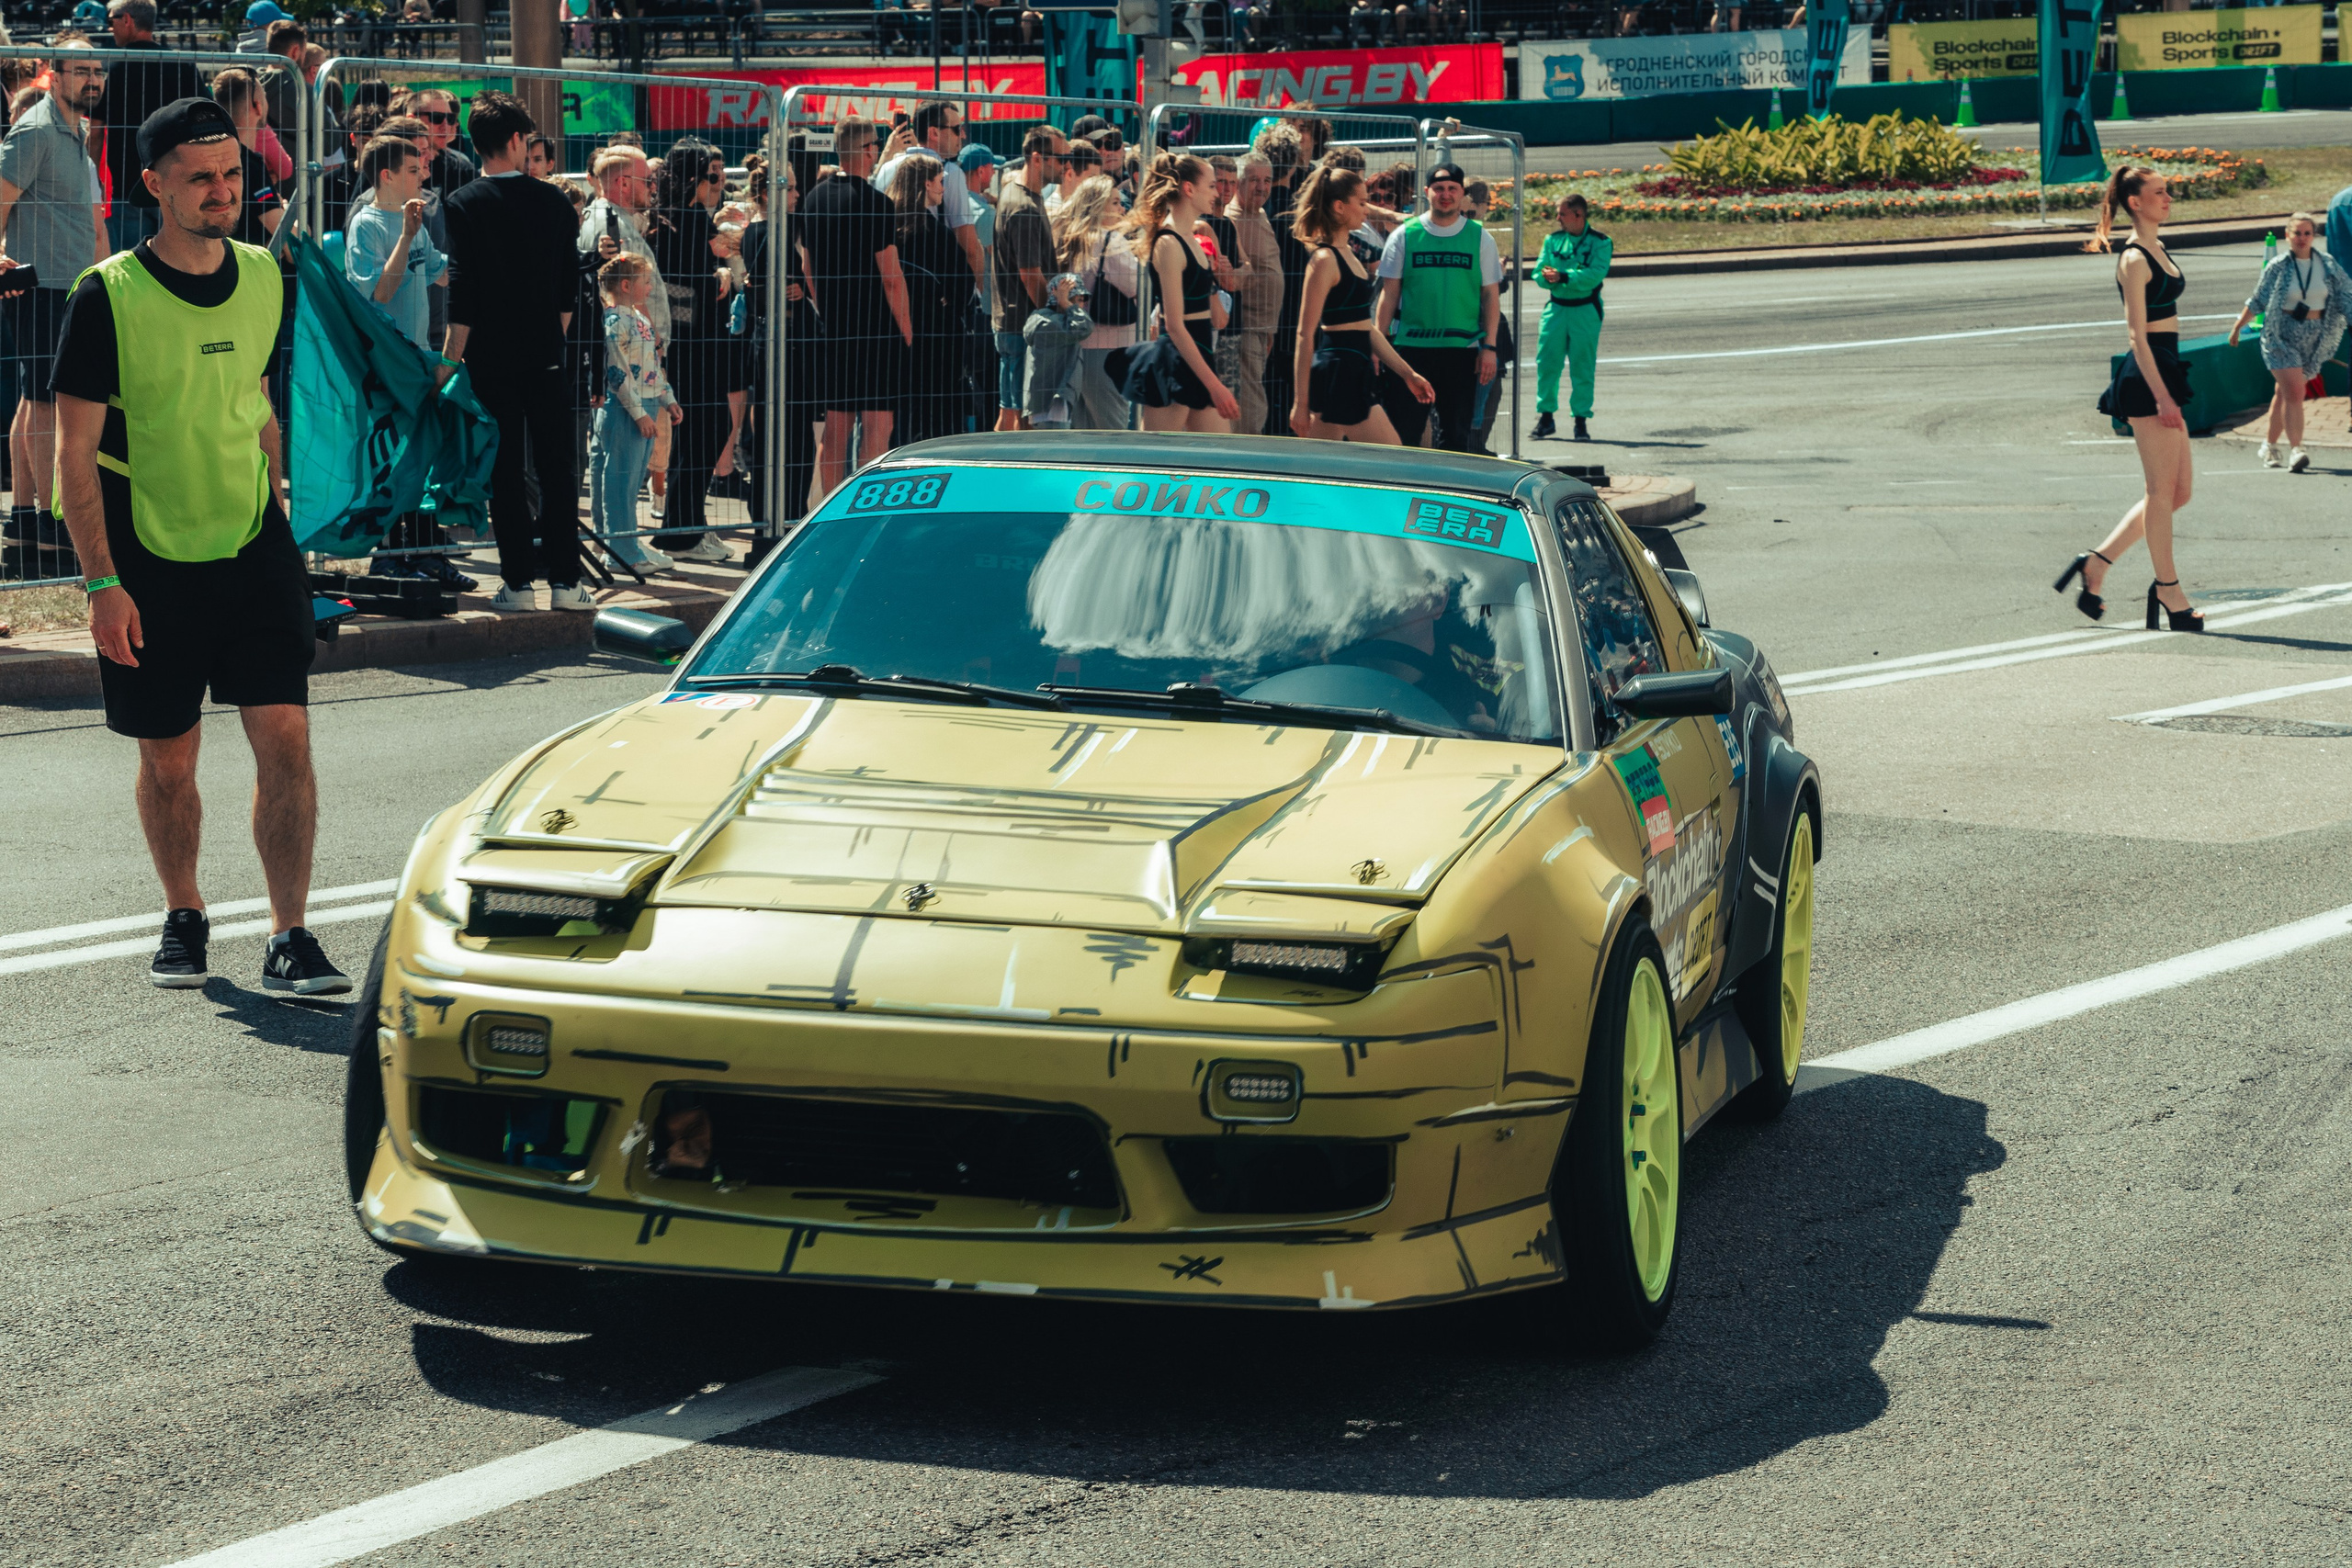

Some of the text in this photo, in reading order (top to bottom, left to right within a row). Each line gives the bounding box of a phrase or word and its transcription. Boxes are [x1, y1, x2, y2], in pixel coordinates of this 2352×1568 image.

[2162, 28, 2268, 44] Blockchain
[1606, 50, 1733, 73] ГРОДНЕНСКИЙ
[1934, 56, 2038, 73] Sports DRI
[2163, 45, 2276, 62] Sports DRIFT
[1140, 61, 1450, 107] ACING.BY
[1597, 67, 1764, 92] ИСПОЛНИТЕЛЬНЫЙ
[854, 478, 943, 509] 888
[1074, 475, 1271, 518] СОЙКО
[1418, 502, 1498, 528] BET
[1645, 812, 1713, 930] Blockchain
